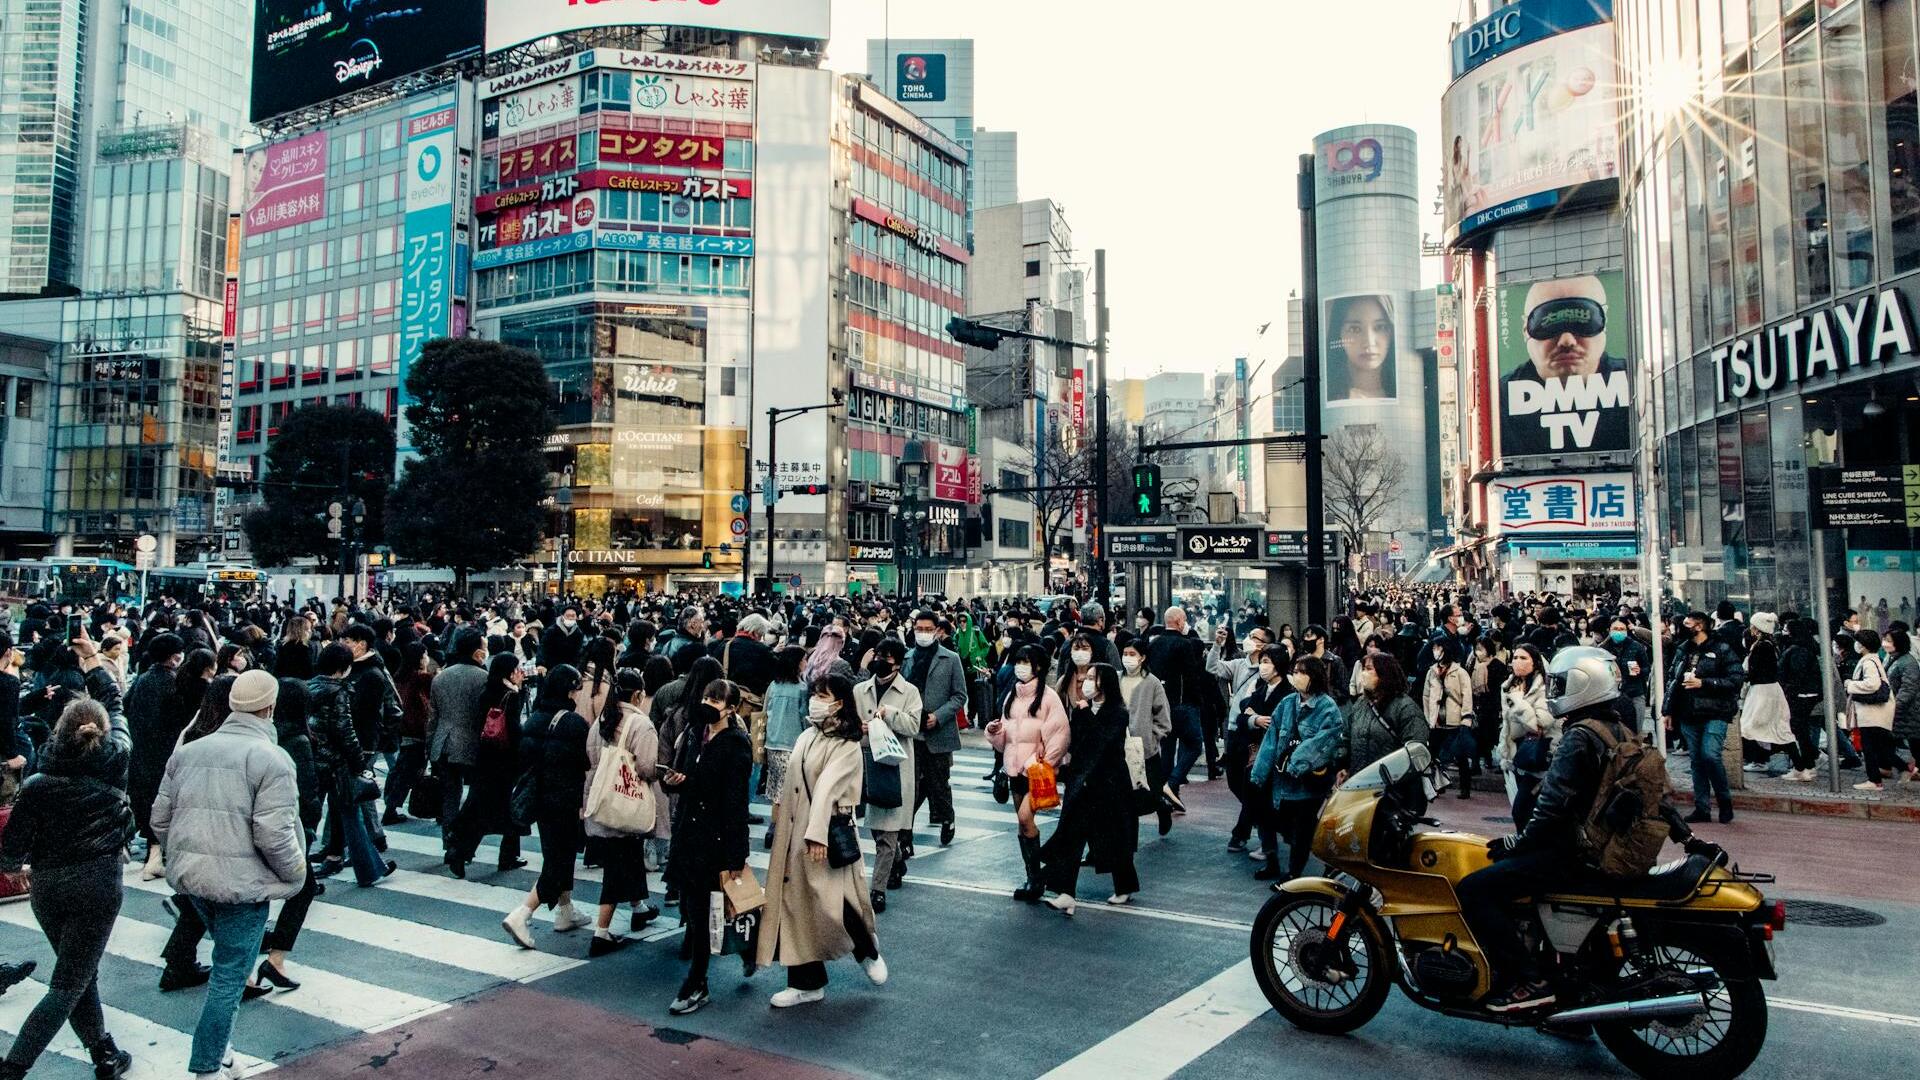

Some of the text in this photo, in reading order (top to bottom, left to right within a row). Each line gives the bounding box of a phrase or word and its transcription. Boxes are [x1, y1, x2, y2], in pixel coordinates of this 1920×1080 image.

[1468, 10, 1520, 57] DHC
[620, 52, 748, 76] しゃぶしゃぶバイキング
[528, 85, 574, 117] しゃぶ葉
[674, 83, 749, 110] しゃぶ葉
[484, 111, 499, 127] 9F
[281, 141, 323, 164] 品川スキン
[501, 140, 575, 177] プライス
[600, 133, 720, 161] コンタクト
[281, 158, 318, 180] クリニック
[1324, 138, 1383, 183] 109
[412, 183, 446, 201] eyecity
[541, 176, 579, 201] ガスト
[682, 176, 738, 199] ガスト
[1327, 174, 1362, 187] SHIBUYA
[256, 193, 320, 225] 品川美容外科
[1477, 200, 1529, 225] DHC Channel
[480, 224, 497, 242] 7F
[522, 209, 568, 240] ガスト
[505, 238, 571, 261] 英会話イーオン
[602, 234, 750, 251] AEON 英会話イーオン
[429, 232, 443, 339] コンタクト
[71, 340, 122, 354] MARK
[1711, 288, 1911, 403] TSUTAYA
[1508, 372, 1629, 416] DMM
[1540, 411, 1600, 449] TV
[941, 467, 962, 483] アコム
[637, 494, 664, 505] Café
[1504, 483, 1625, 520] 堂書店
[929, 506, 959, 525] LUSH
[863, 547, 893, 559] サンドラッグ
[1209, 536, 1251, 547] しぶちか
